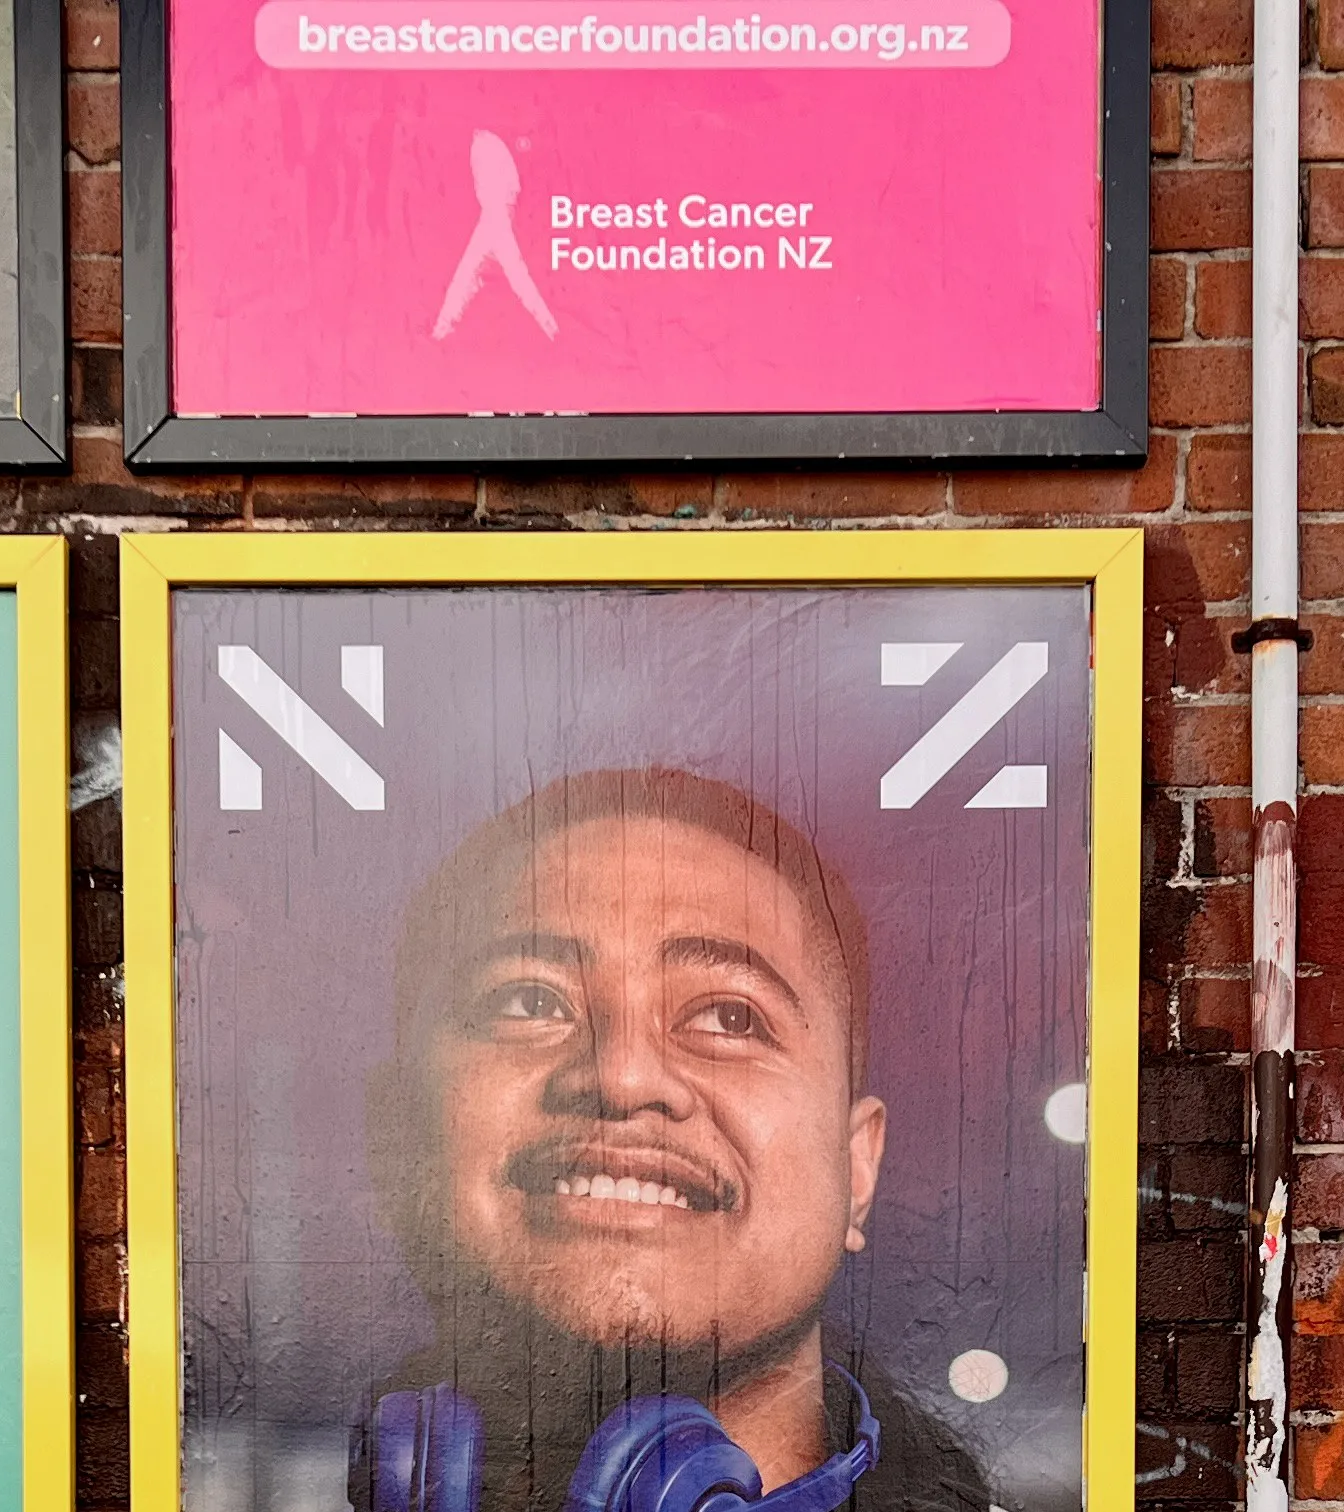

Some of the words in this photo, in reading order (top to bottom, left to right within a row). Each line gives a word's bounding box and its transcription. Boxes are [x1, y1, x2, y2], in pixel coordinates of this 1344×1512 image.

[298, 16, 969, 60] breastcancerfoundation.org.nz
[550, 195, 668, 228] Breast
[678, 194, 813, 228] Cancer
[550, 236, 765, 270] Foundation
[777, 235, 833, 269] NZ
